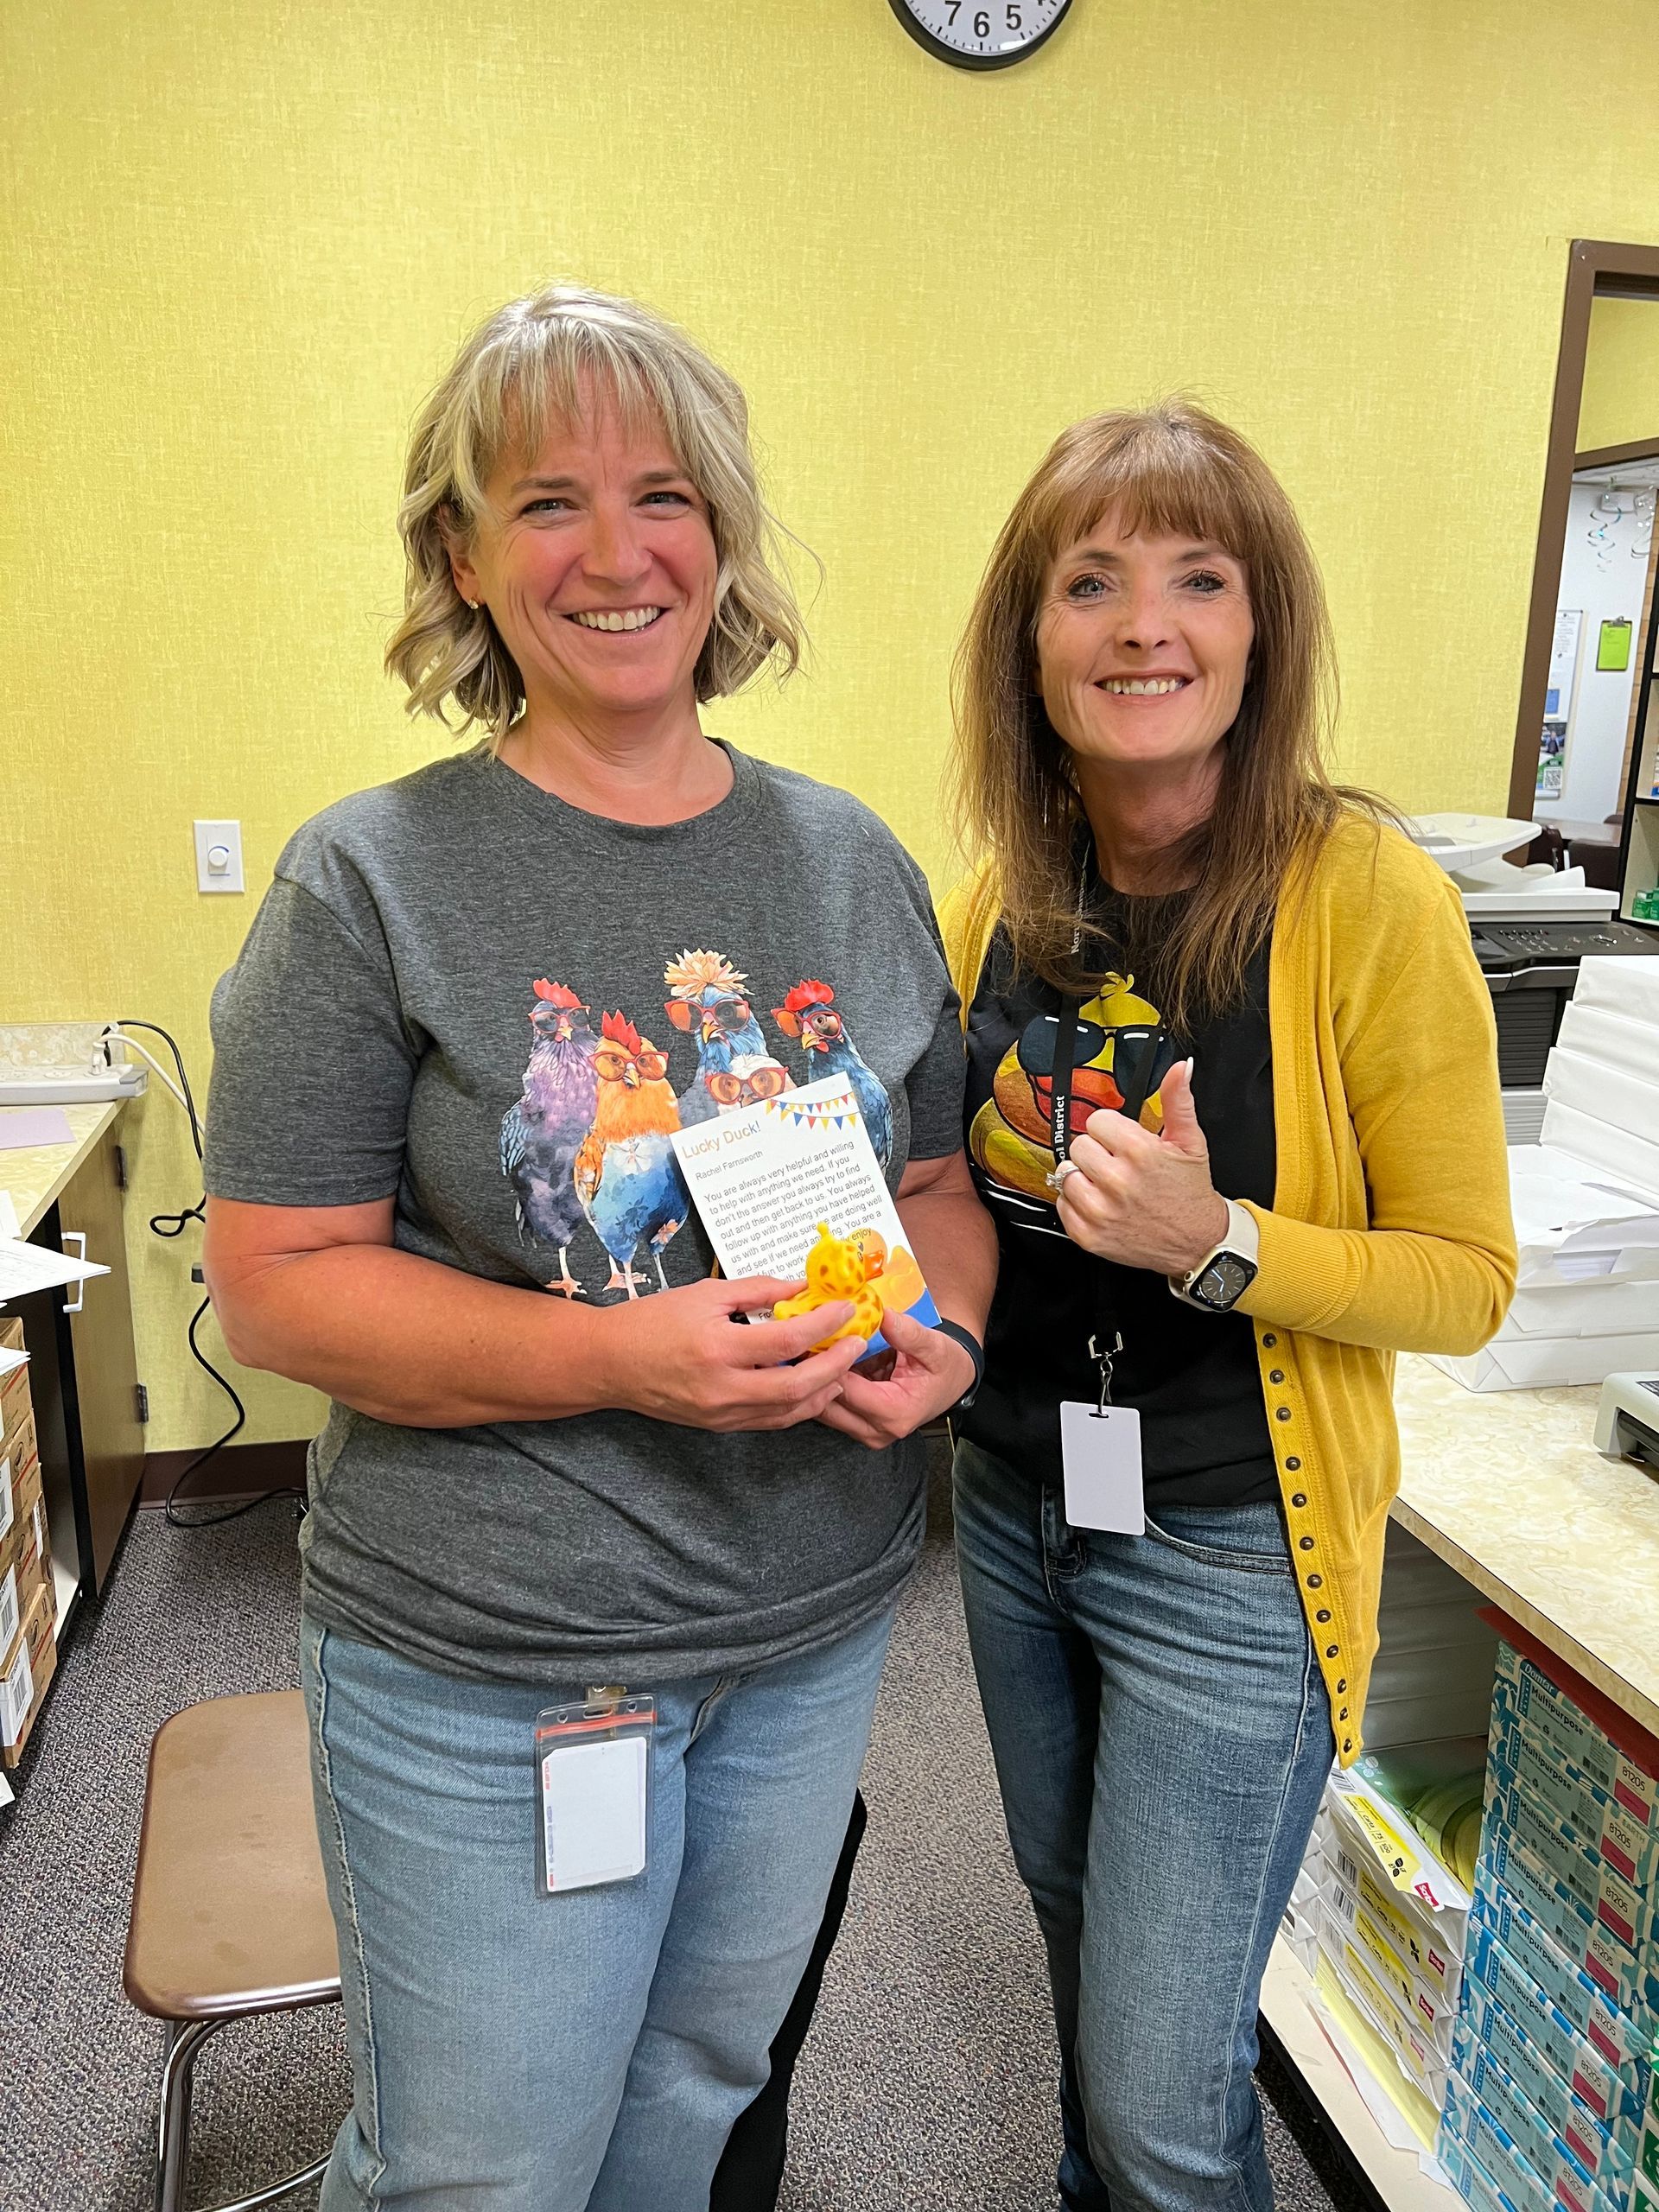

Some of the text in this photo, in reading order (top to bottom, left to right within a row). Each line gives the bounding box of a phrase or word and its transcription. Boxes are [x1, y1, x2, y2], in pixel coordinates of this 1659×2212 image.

[945, 1, 961, 26] 7
[974, 11, 990, 38] 6
[1006, 4, 1022, 30] 5
[682, 1121, 761, 1158] Lucky Duck!
[1055, 1095, 1065, 1144] District
[695, 1151, 763, 1180] Rachel Farnsworth
[704, 1142, 854, 1202] You are always very helpful and willing
[719, 1200, 737, 1211] help
[739, 1192, 756, 1203] with
[758, 1180, 791, 1196] anything
[791, 1174, 804, 1183] we
[828, 1160, 834, 1168] If
[835, 1157, 850, 1168] you
[716, 1214, 736, 1227] don't
[737, 1210, 750, 1219] the
[751, 1197, 779, 1213] answer
[781, 1191, 796, 1203] you
[798, 1180, 824, 1195] always
[825, 1175, 835, 1184] try
[846, 1164, 860, 1175] find
[721, 1229, 734, 1239] out
[735, 1222, 751, 1234] and
[752, 1216, 770, 1227] then
[772, 1208, 784, 1221] get
[784, 1201, 804, 1213] back
[827, 1186, 844, 1195] You
[845, 1175, 871, 1189] always
[725, 1184, 875, 1251] follow up with anything you have helped
[731, 1255, 741, 1263] us
[742, 1247, 759, 1258] with
[760, 1239, 776, 1251] and
[777, 1232, 798, 1244] make
[800, 1224, 817, 1235] sure
[831, 1213, 844, 1222] are
[845, 1204, 866, 1216] doing
[867, 1195, 882, 1207] well
[737, 1263, 752, 1276] and
[753, 1258, 768, 1269] see
[775, 1250, 788, 1259] we
[789, 1239, 809, 1254] need
[844, 1219, 861, 1229] You
[862, 1214, 875, 1223] are
[786, 1256, 805, 1268] work
[852, 1227, 871, 1241] enjoy
[1525, 1663, 1554, 1693] Domtar
[1532, 1685, 1583, 1735] Multipurpose
[1522, 1738, 1571, 1791] Multipurpose
[1623, 1766, 1645, 1791] 81205
[1521, 1799, 1569, 1853] Multipurpose
[1609, 1823, 1631, 1848] 81205
[1508, 1850, 1555, 1905] Multipurpose
[1606, 1887, 1627, 1913] 81205
[1512, 1915, 1559, 1973] Multipurpose
[1593, 1940, 1613, 1966] 81205
[1500, 1963, 1546, 2021] Multipurpose
[1494, 2017, 1539, 2076] Multipurpose
[1596, 2009, 1616, 2036] 81205
[1486, 2067, 1530, 2127] Multipurpose
[1581, 2060, 1602, 2087] 81205
[1573, 2115, 1592, 2143] 81205
[1563, 2168, 1583, 2196] 81205
